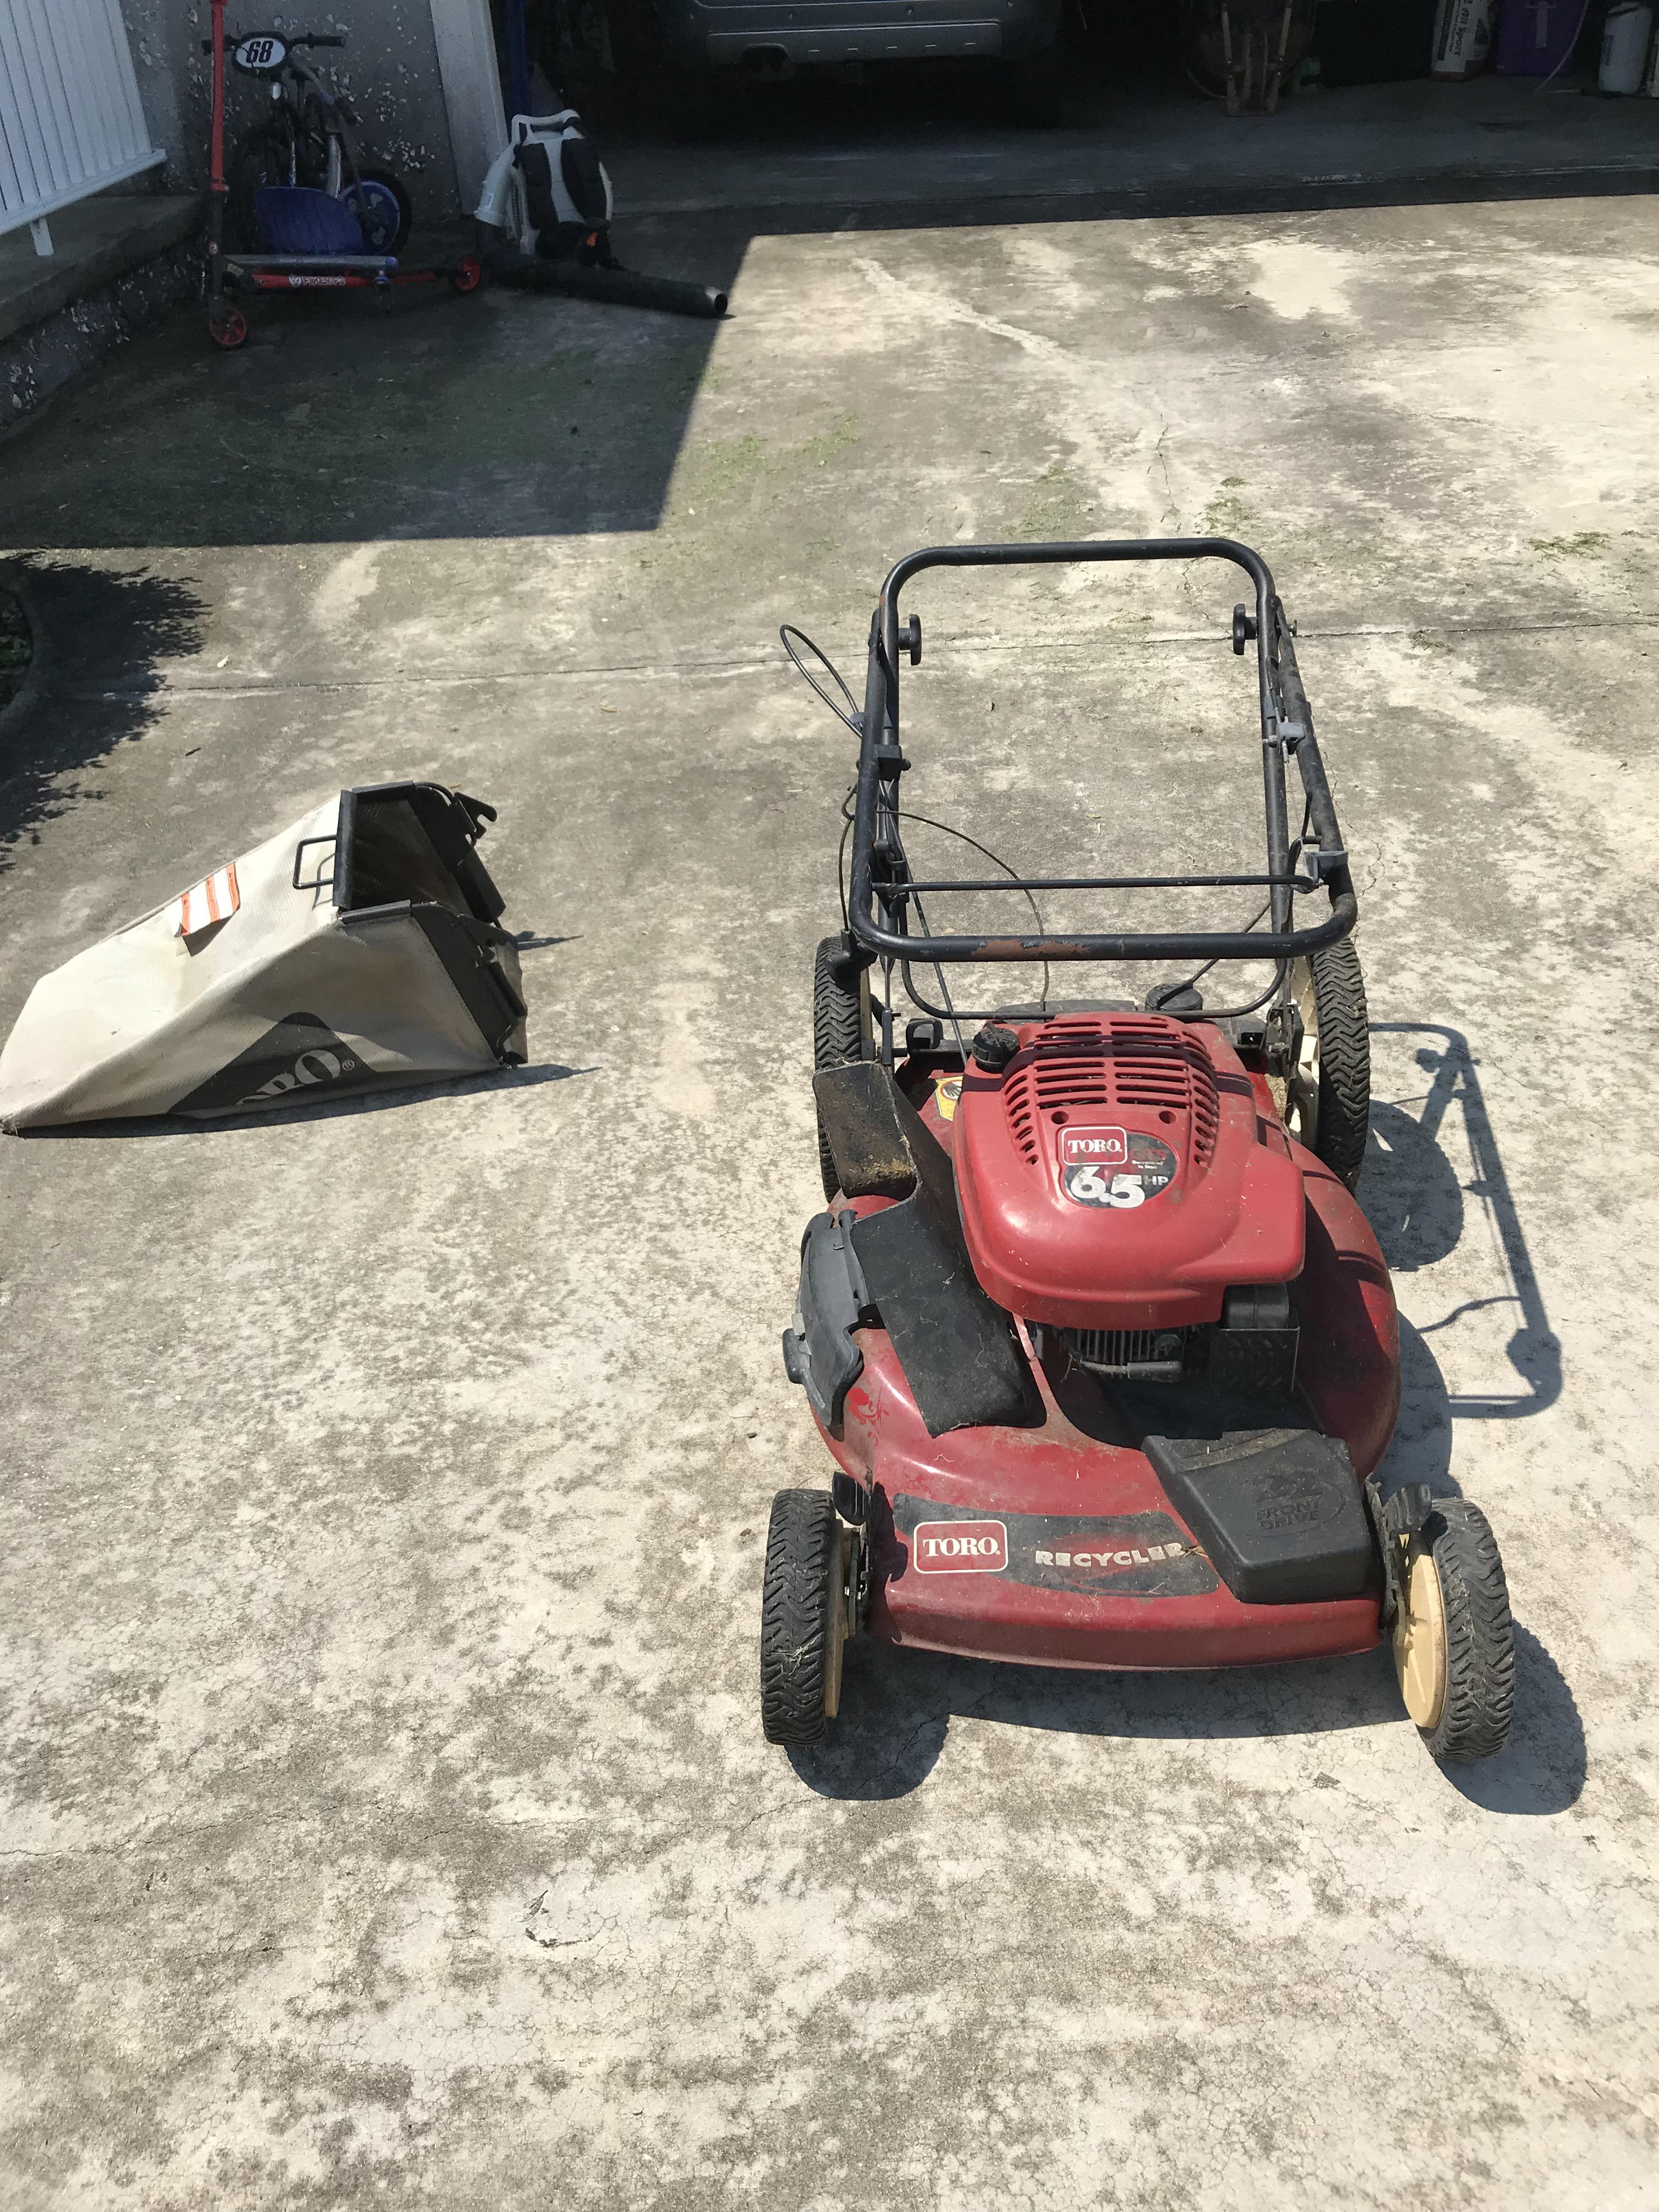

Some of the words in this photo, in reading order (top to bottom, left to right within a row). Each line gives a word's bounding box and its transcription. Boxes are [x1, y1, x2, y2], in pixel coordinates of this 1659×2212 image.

[246, 41, 274, 63] 68
[236, 1049, 341, 1105] RO
[1068, 1139, 1121, 1153] TORO
[1144, 1176, 1169, 1186] HP
[1256, 1502, 1319, 1521] FRONT
[1260, 1510, 1318, 1531] DRIVE
[923, 1537, 998, 1557] TORO
[1035, 1542, 1185, 1567] RECYCLER
